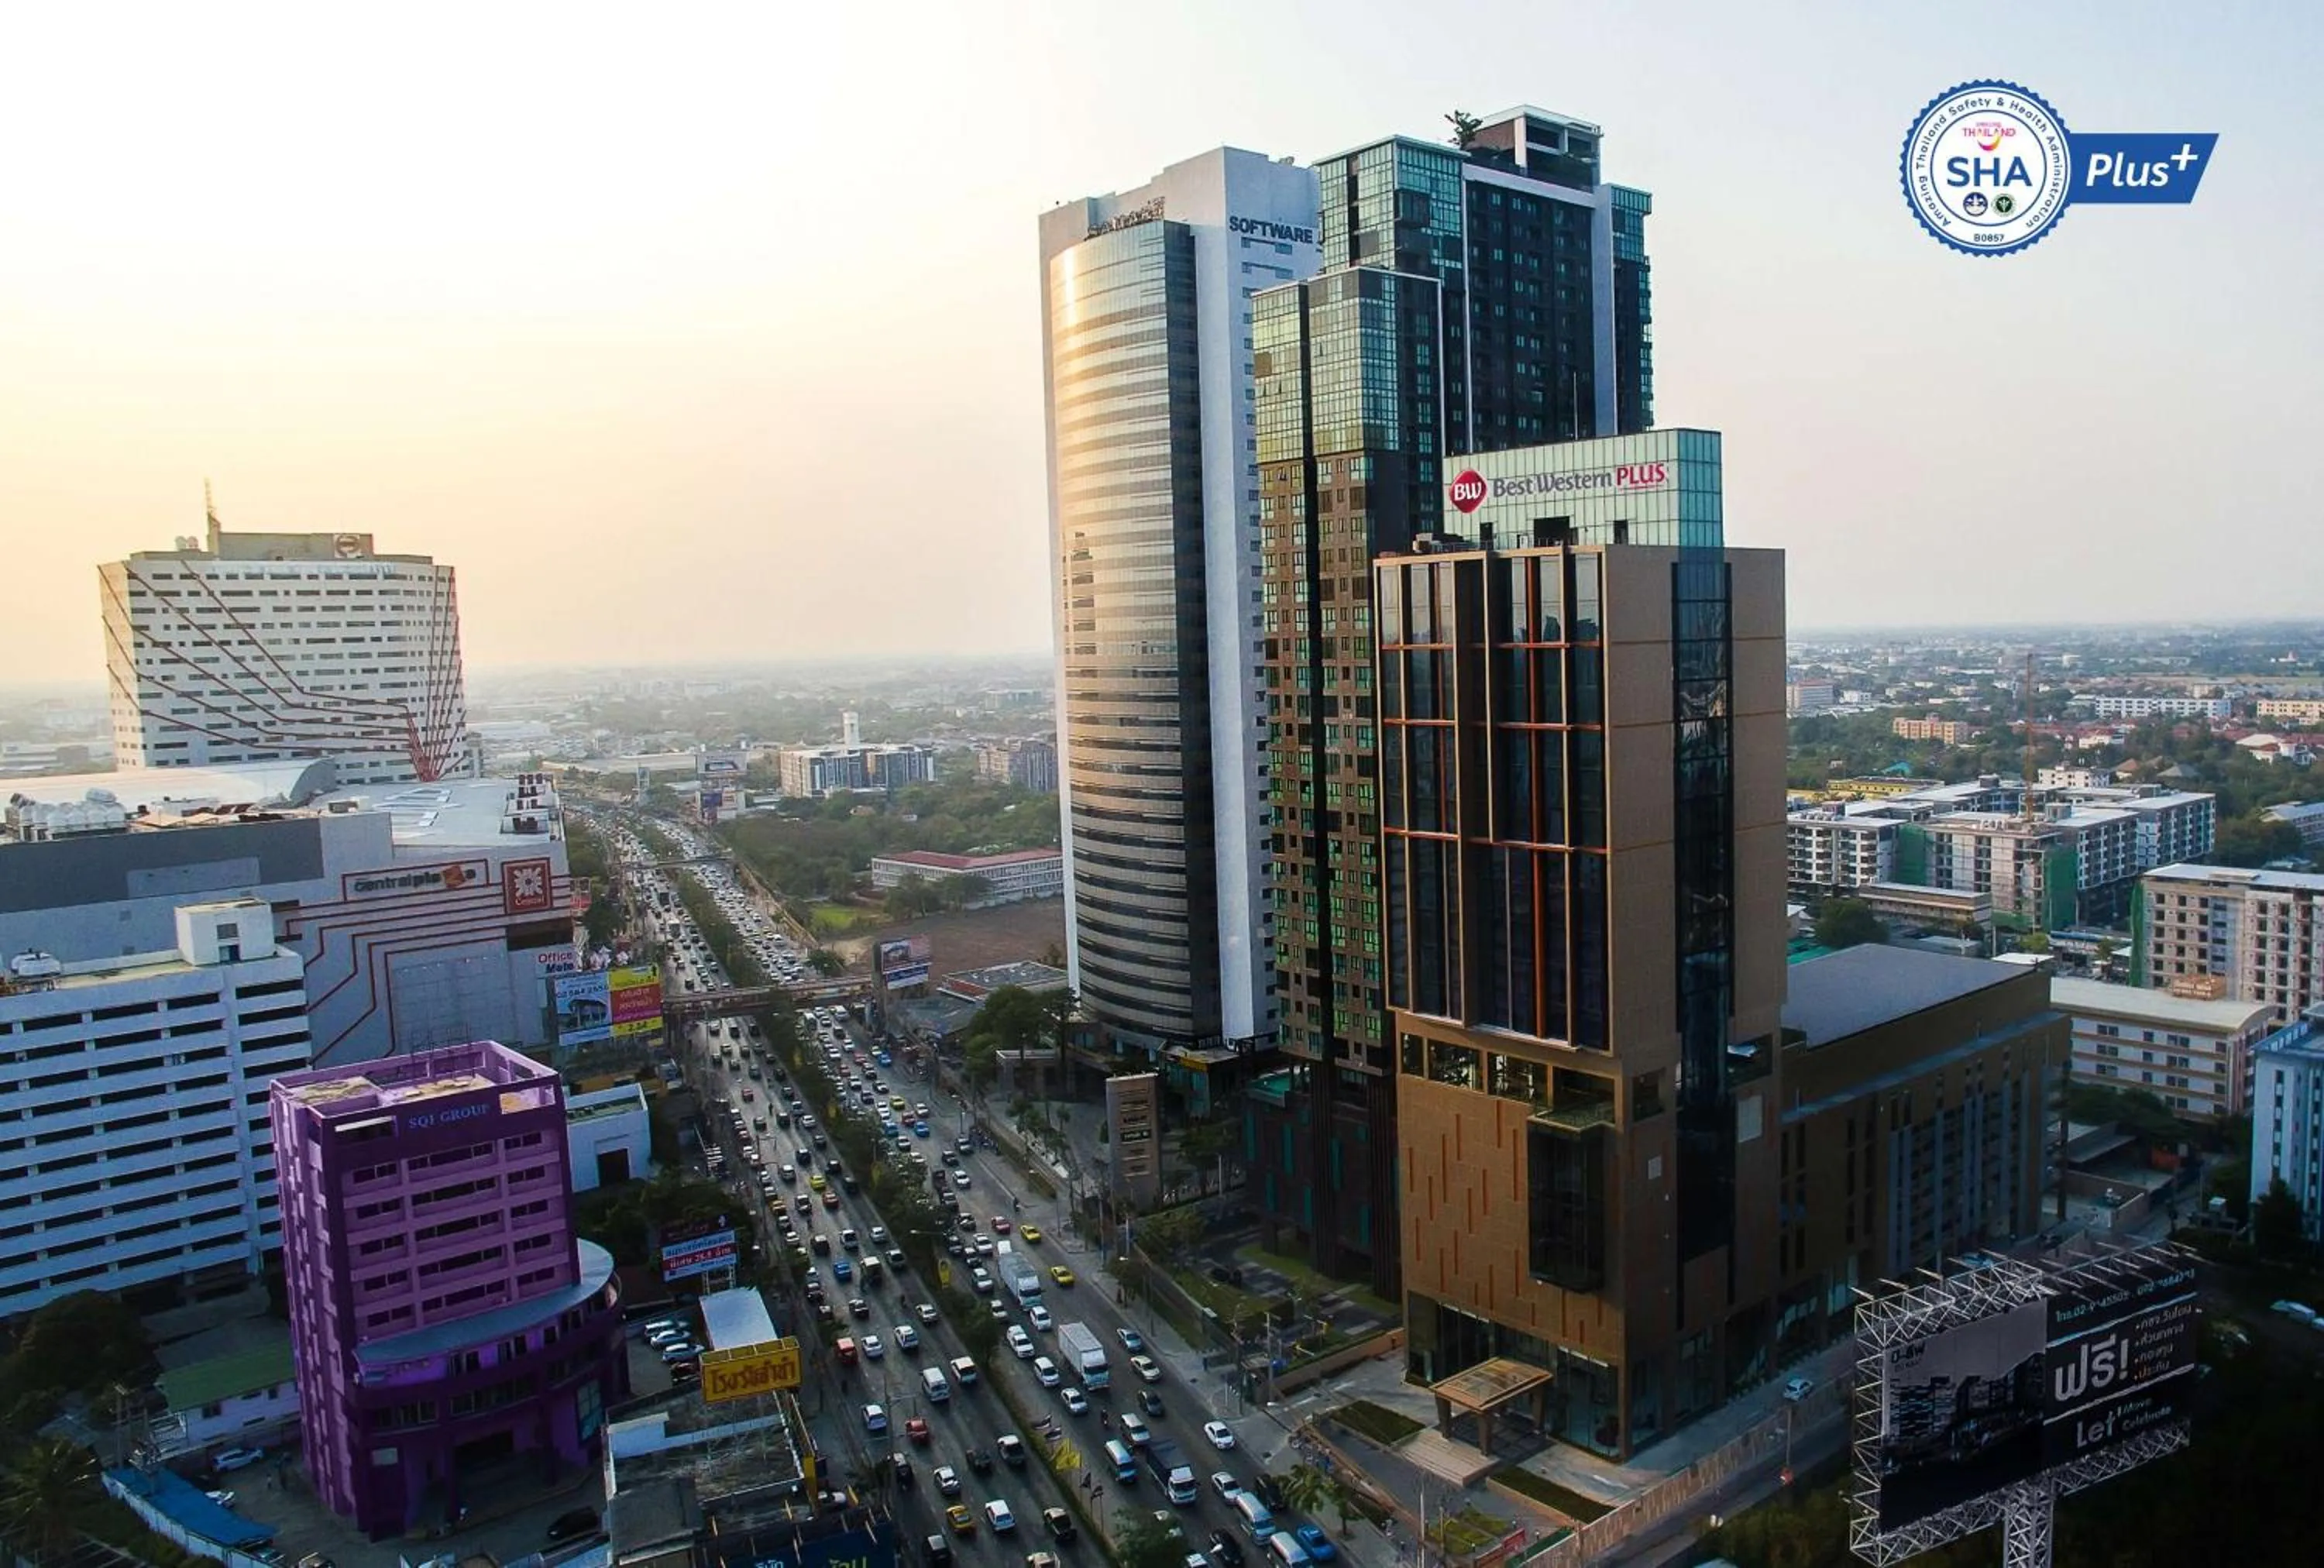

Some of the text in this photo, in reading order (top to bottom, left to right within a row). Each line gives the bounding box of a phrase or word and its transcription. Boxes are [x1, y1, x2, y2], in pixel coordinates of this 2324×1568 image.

[1229, 215, 1314, 244] SOFTWARE
[1616, 462, 1666, 487] PLUS
[1452, 482, 1483, 501] BW
[538, 952, 573, 963] Office
[439, 1103, 490, 1123] GROUP
[2054, 1332, 2130, 1401] ฟรี!
